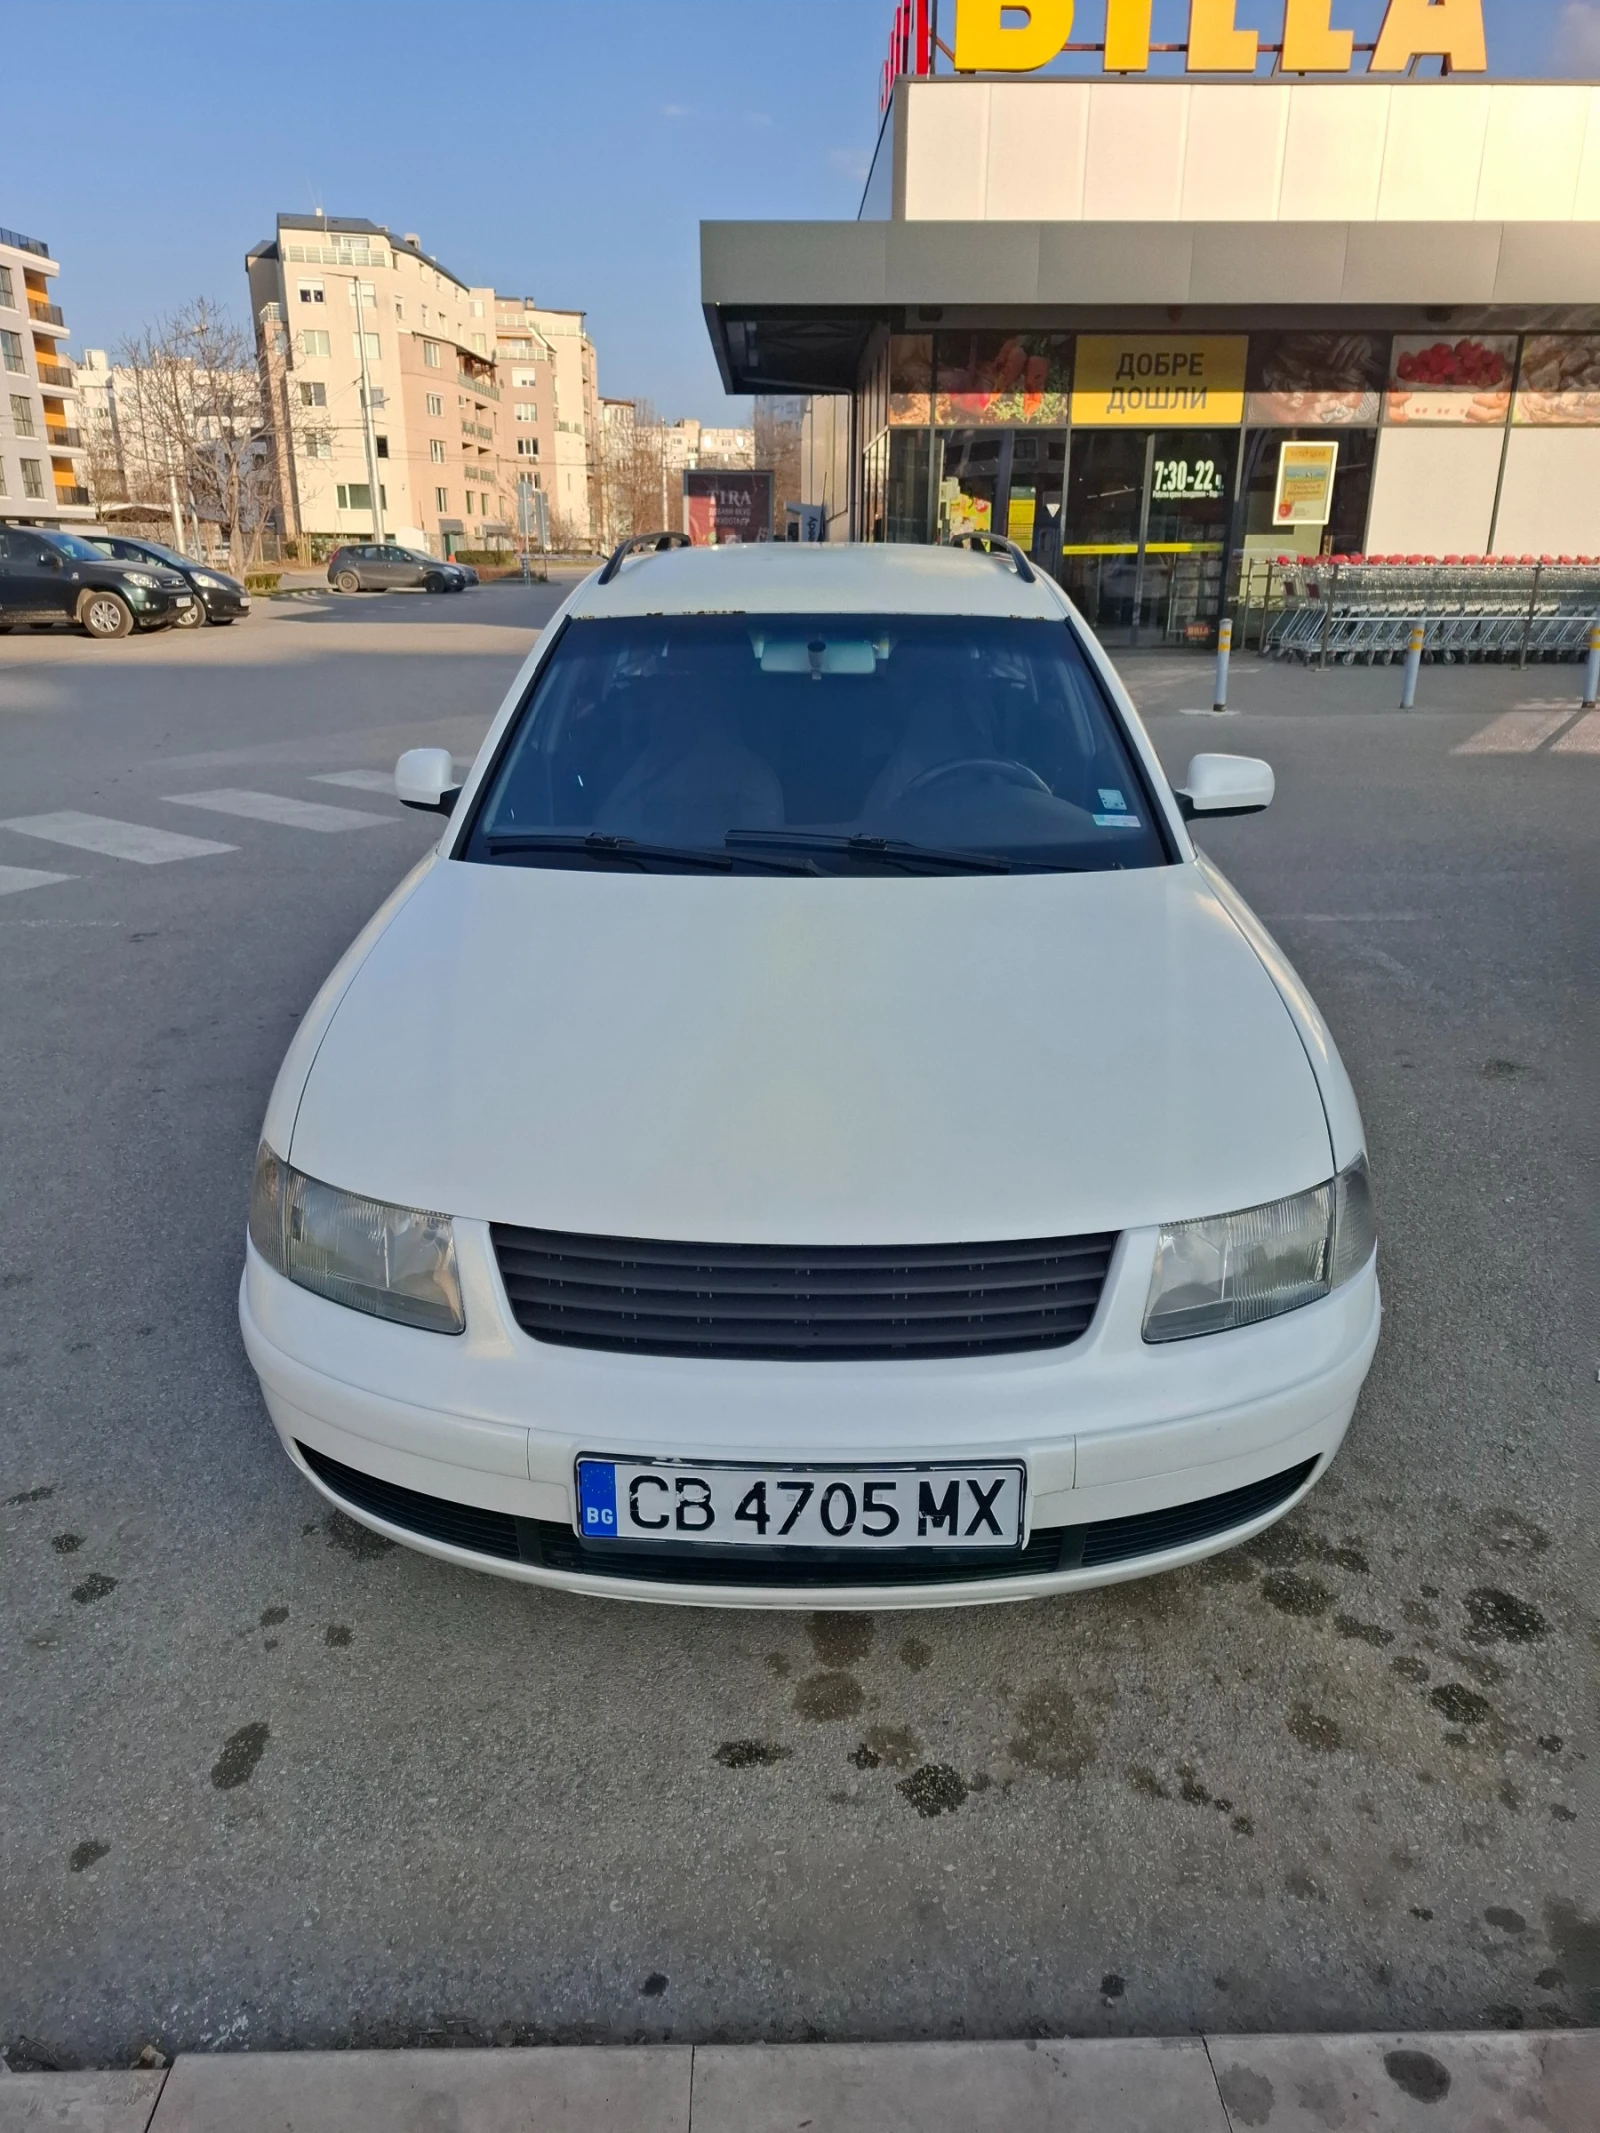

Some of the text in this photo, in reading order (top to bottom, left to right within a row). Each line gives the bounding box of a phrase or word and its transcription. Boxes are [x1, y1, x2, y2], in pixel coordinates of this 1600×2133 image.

[1115, 352, 1205, 381] ДОБРЕ
[1105, 386, 1208, 414] ДОШЛИ
[1154, 460, 1215, 491] 7:30-22
[586, 1507, 614, 1525] BG
[629, 1474, 1007, 1538] CB 4705 MX
